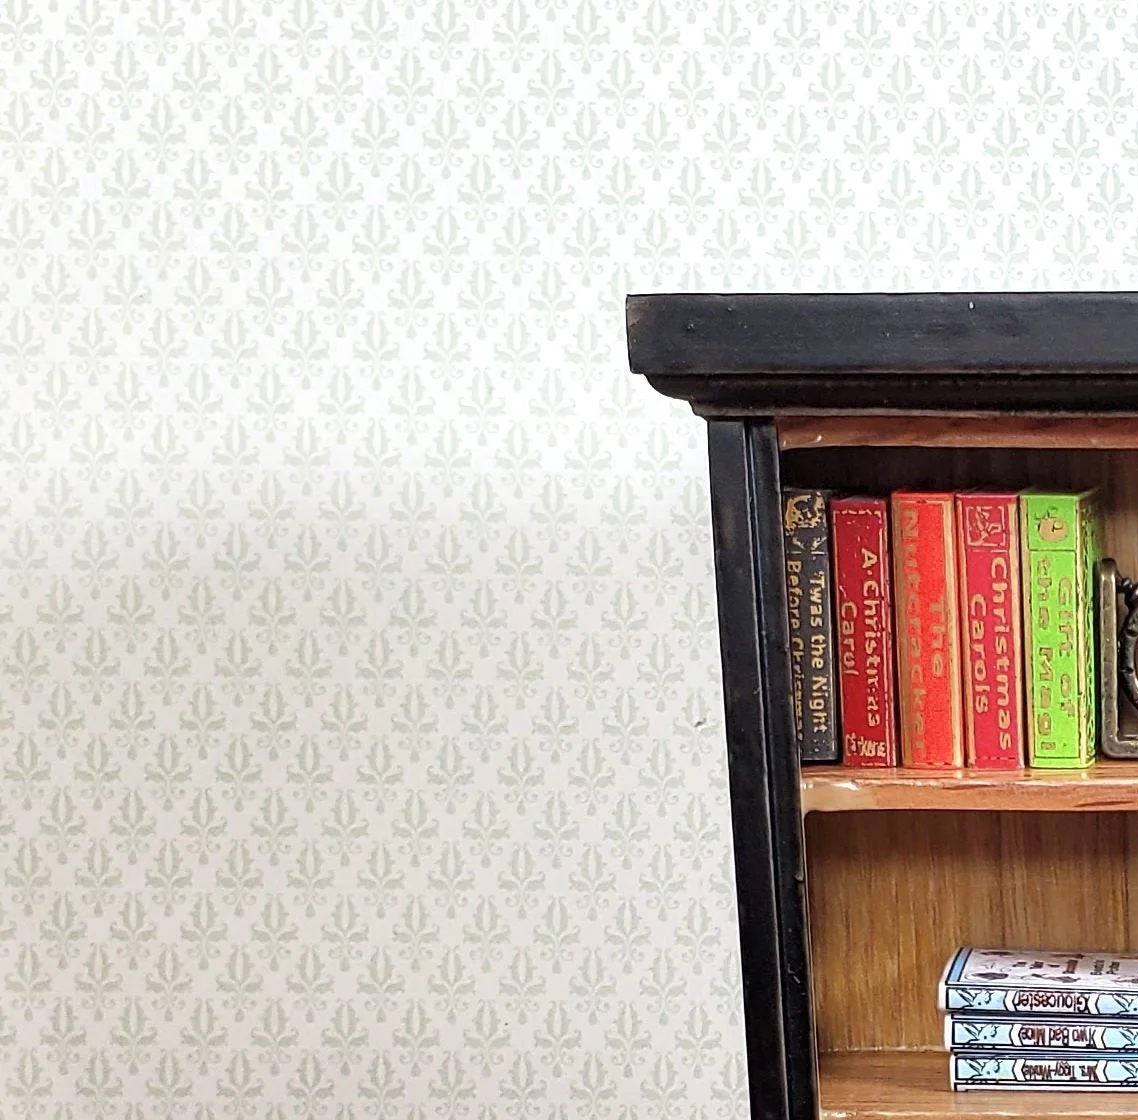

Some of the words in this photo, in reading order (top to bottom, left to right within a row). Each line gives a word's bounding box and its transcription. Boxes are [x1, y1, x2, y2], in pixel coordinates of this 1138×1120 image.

[1037, 556, 1052, 629] the
[1058, 577, 1074, 657] Gift
[811, 634, 826, 669] the
[841, 602, 859, 676] Carol
[903, 509, 927, 751] Nutcracker
[929, 594, 945, 677] The
[970, 594, 990, 713] Carols
[991, 557, 1011, 750] Christmas
[809, 675, 828, 733] Night
[1037, 647, 1056, 750] Magi
[1060, 673, 1075, 717] of
[1016, 991, 1087, 1012] Gloucester
[1021, 1027, 1045, 1046] Mice
[1048, 1027, 1069, 1046] Bad
[1072, 1028, 1094, 1047] Two
